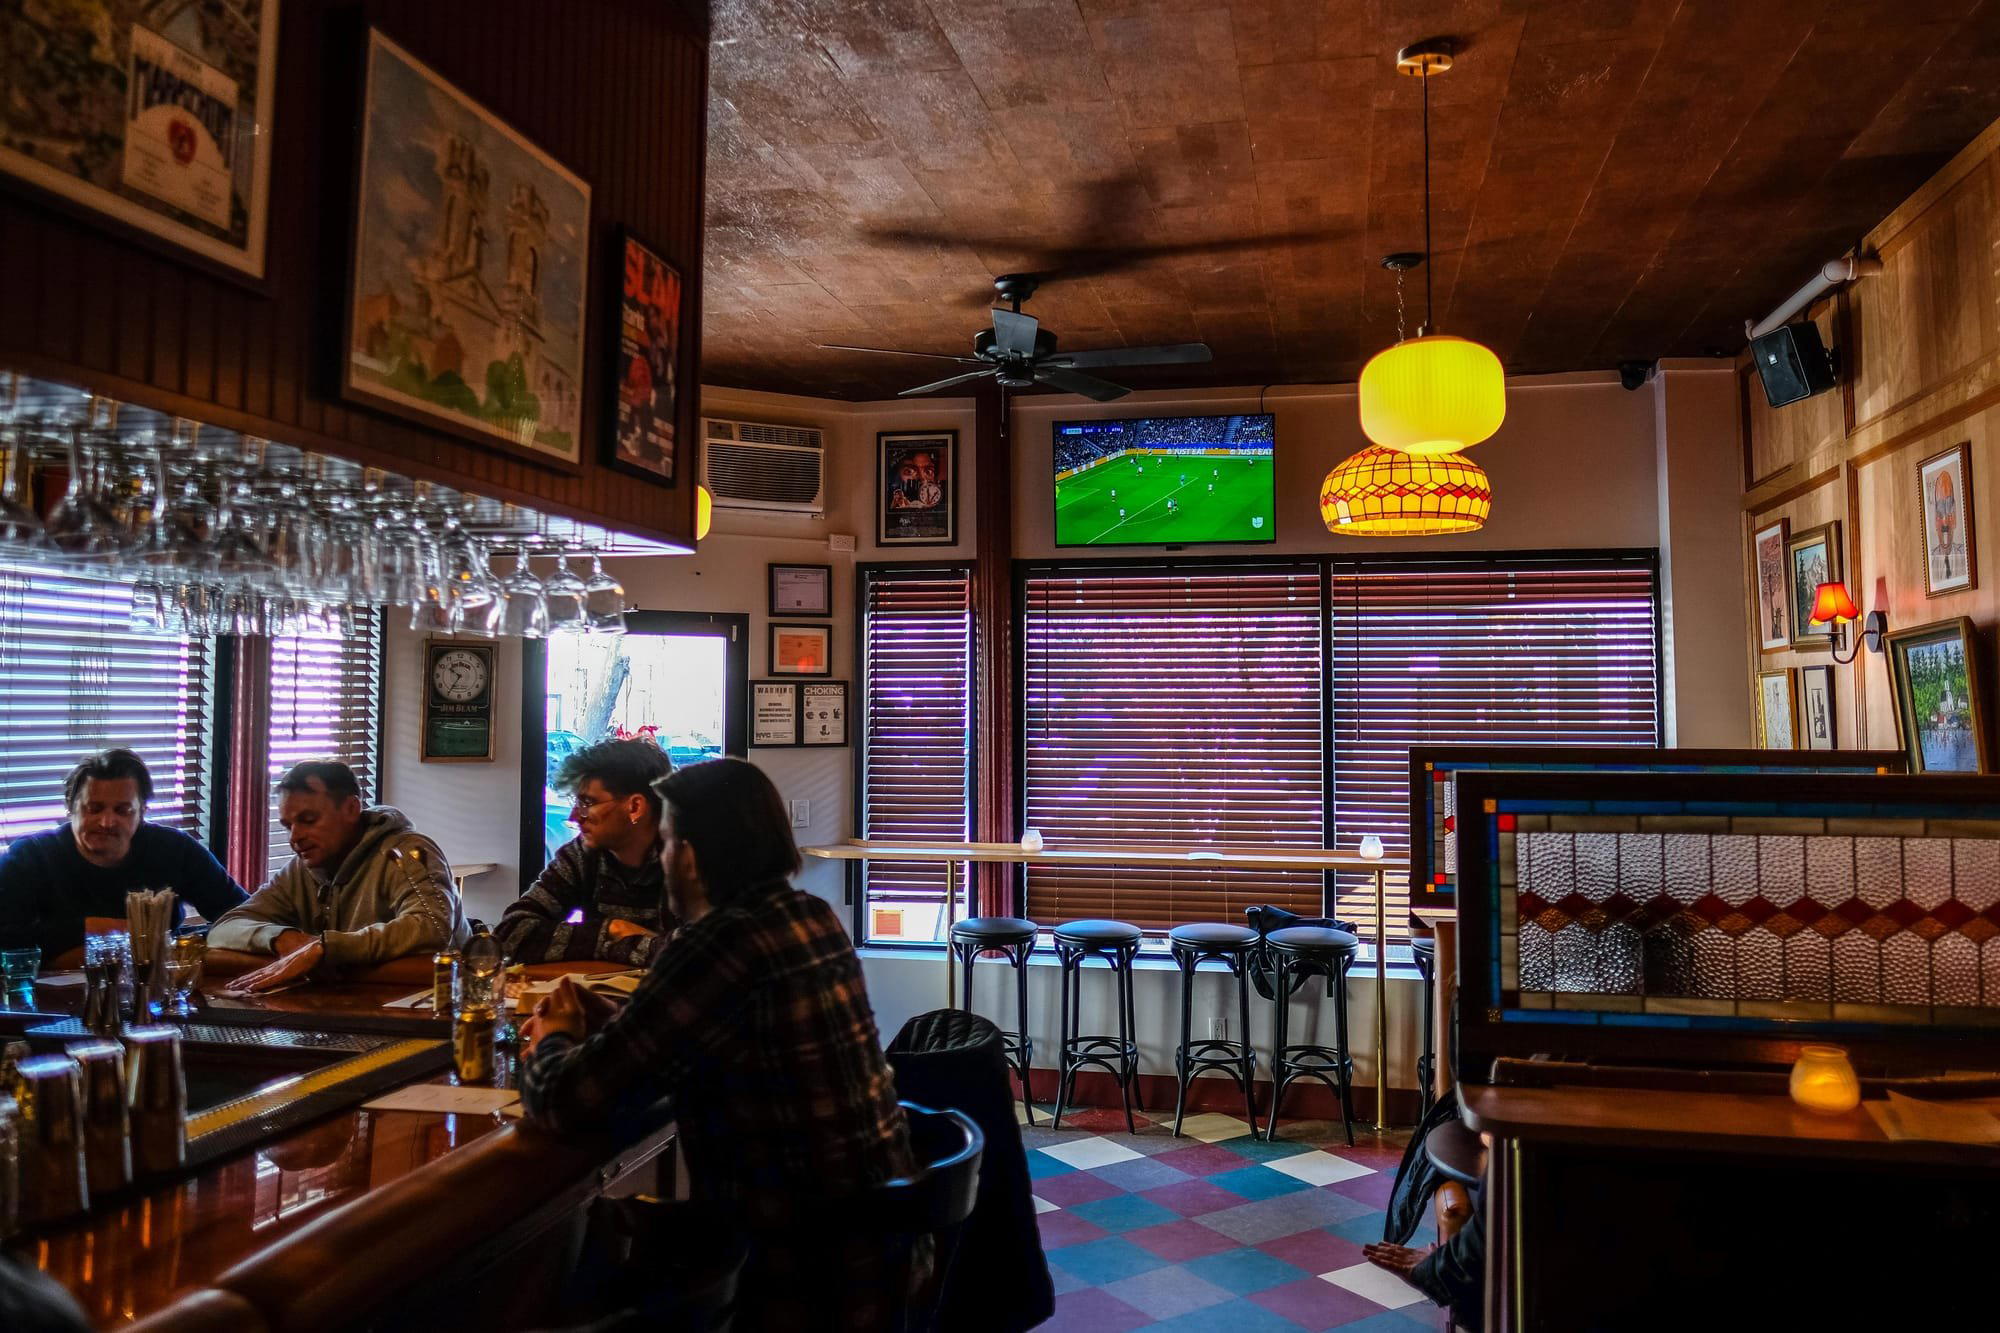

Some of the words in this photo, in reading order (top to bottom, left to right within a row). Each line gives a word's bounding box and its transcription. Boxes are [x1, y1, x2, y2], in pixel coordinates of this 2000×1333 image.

[624, 240, 680, 322] SLAM
[804, 687, 844, 695] CHOKING
[440, 704, 455, 712] JIM
[455, 704, 478, 712] BEAM
